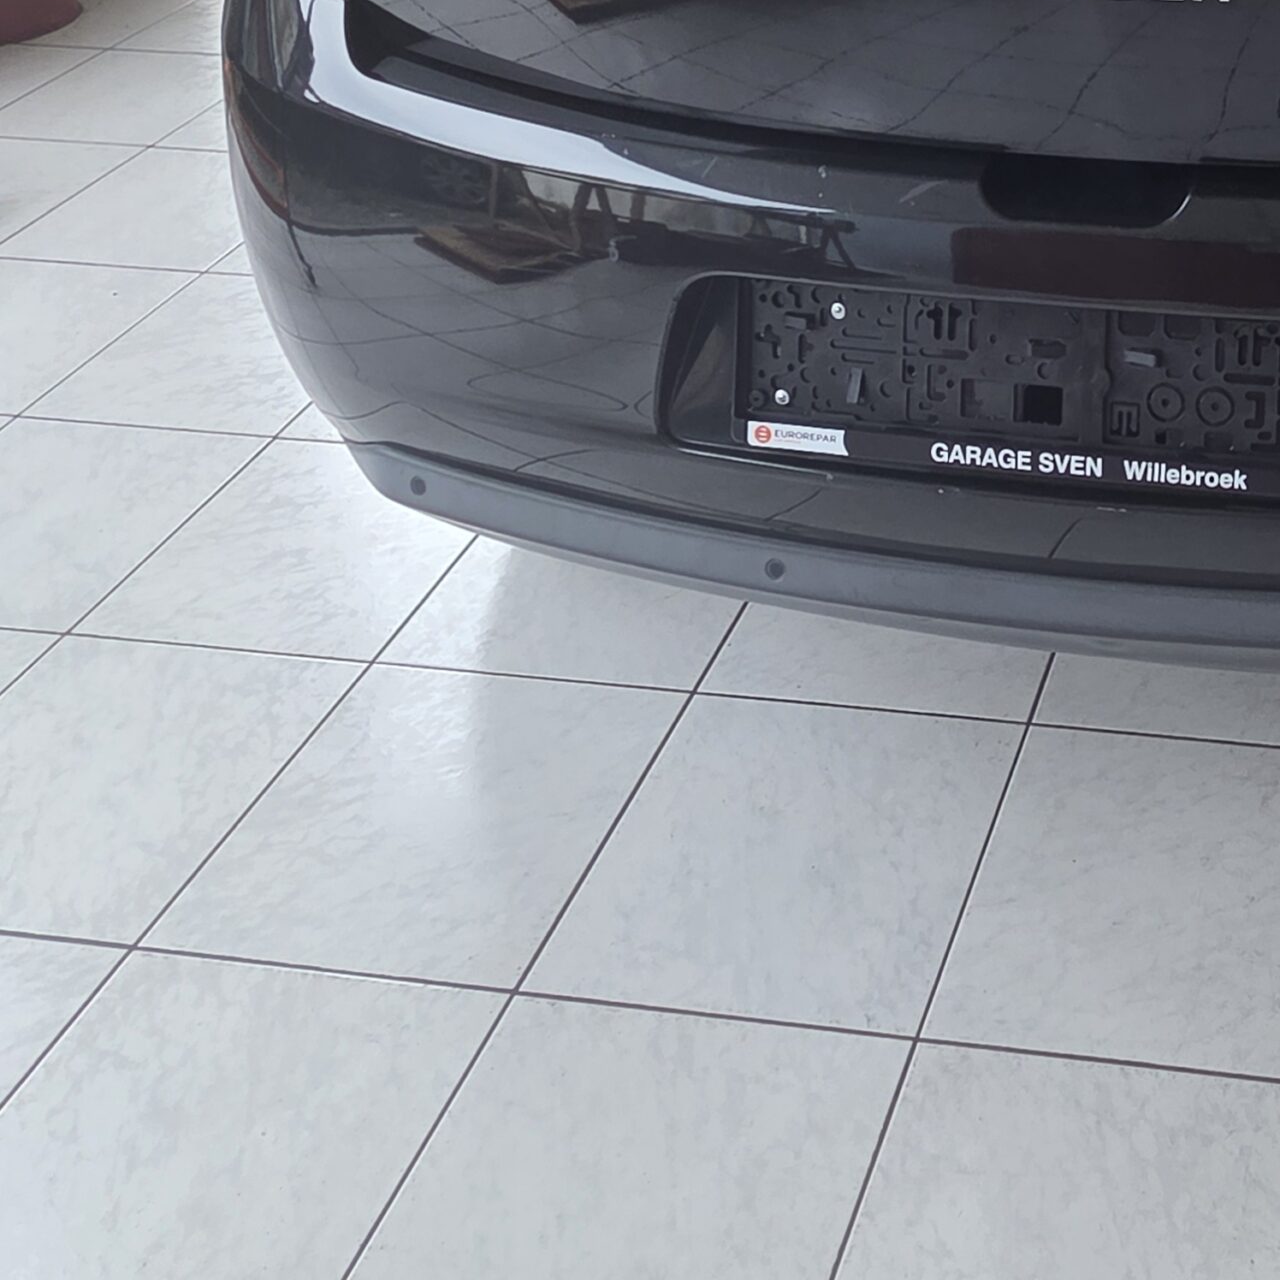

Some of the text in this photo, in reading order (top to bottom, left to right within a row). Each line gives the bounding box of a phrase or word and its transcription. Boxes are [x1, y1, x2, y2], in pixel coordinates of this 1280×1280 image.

[774, 429, 837, 443] EUROREPAR
[930, 442, 1248, 490] GARAGE SVEN Willebroek
